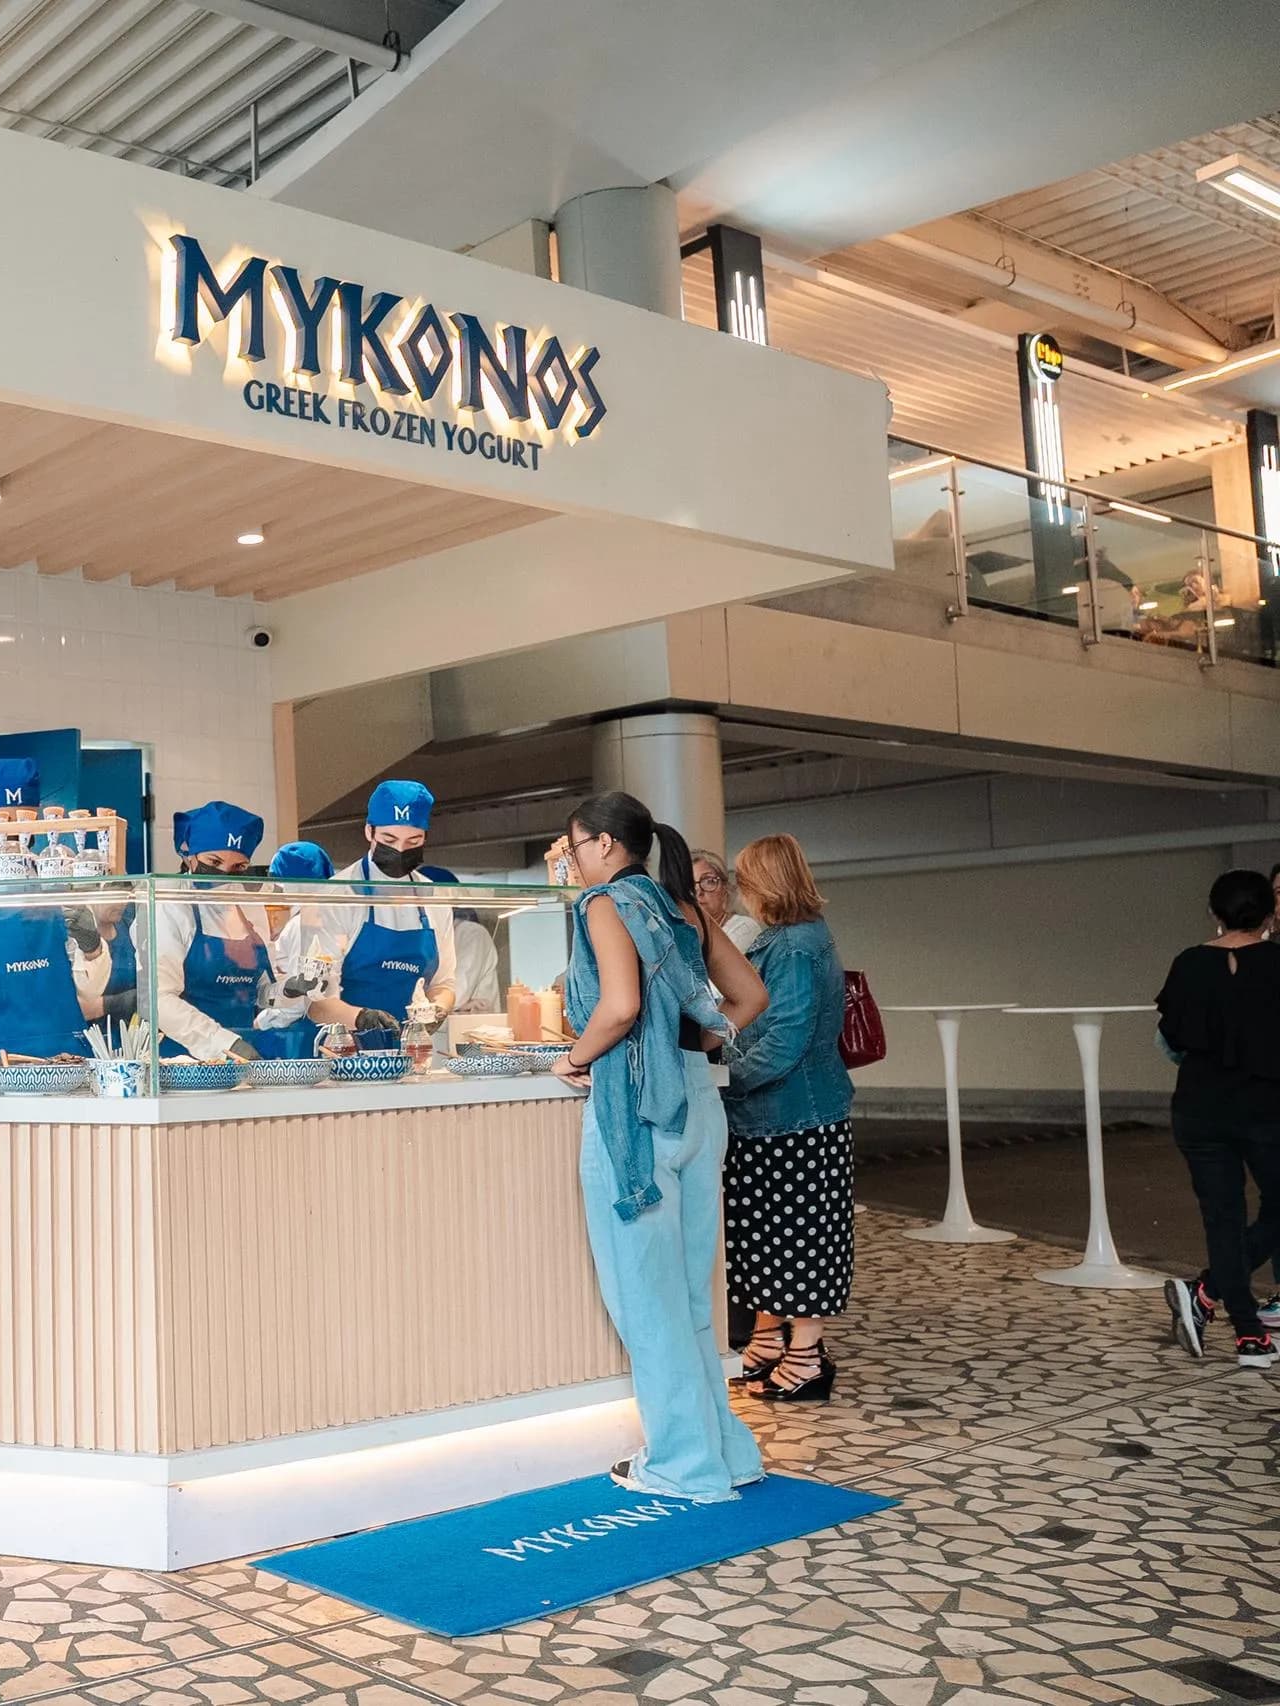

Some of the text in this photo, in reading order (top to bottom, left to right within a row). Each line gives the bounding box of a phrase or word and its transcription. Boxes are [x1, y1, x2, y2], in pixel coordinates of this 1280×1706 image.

[169, 234, 607, 438] MYKONOS
[243, 380, 543, 470] GREEK FROZEN YOGURT
[5, 787, 22, 805] M
[394, 805, 410, 821] M
[227, 832, 242, 849] M
[6, 957, 50, 973] MYKONOS
[381, 960, 420, 973] MYKONOS
[482, 1498, 688, 1561] MYKONOS
